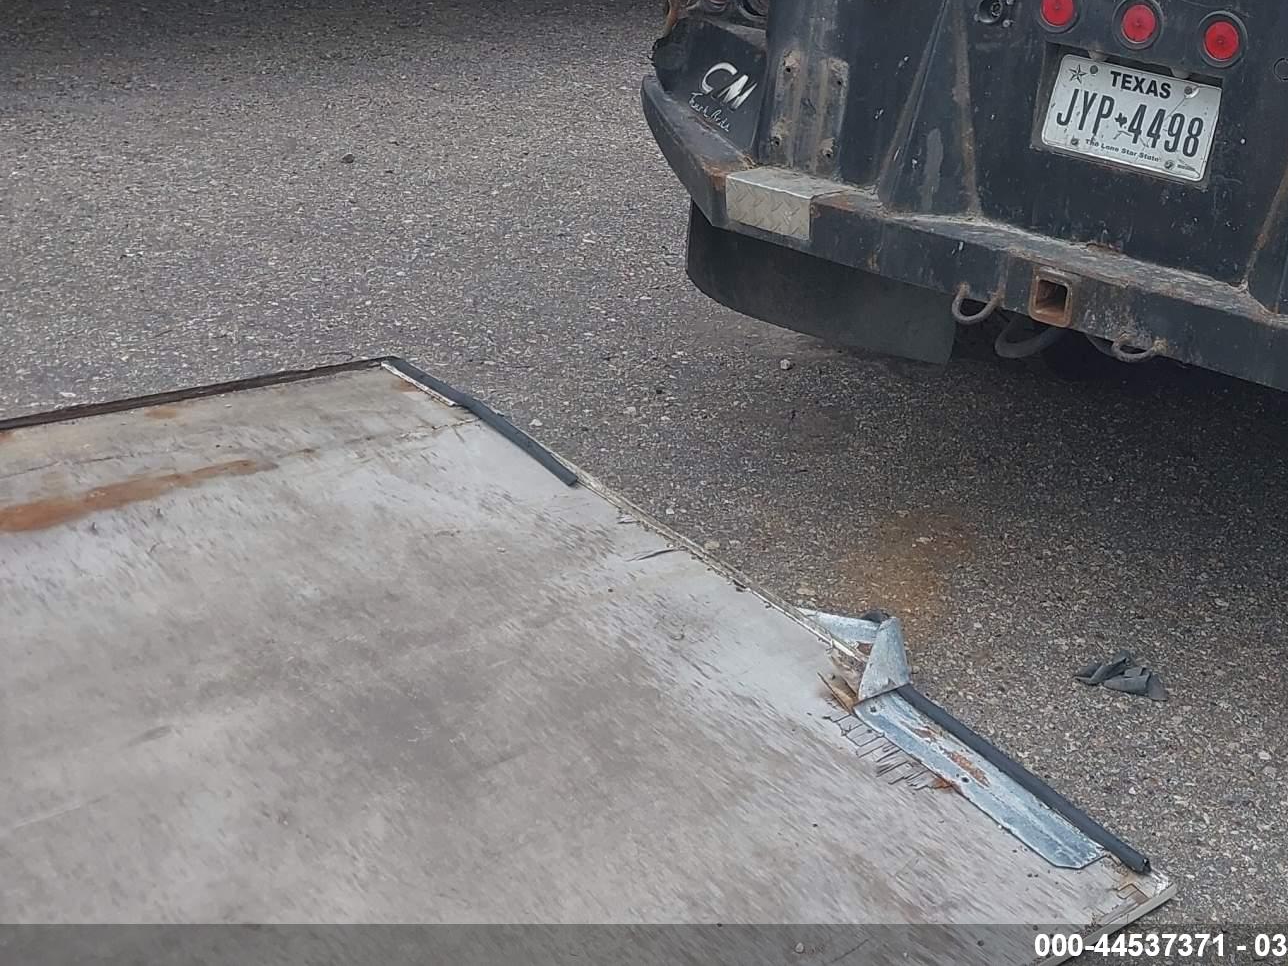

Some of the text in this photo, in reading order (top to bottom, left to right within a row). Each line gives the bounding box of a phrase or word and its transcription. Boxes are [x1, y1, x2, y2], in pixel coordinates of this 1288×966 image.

[701, 62, 757, 110] CM
[1110, 70, 1172, 99] TEXAS
[1085, 135, 1160, 163] The Lone Star State
[1127, 104, 1204, 158] 4498
